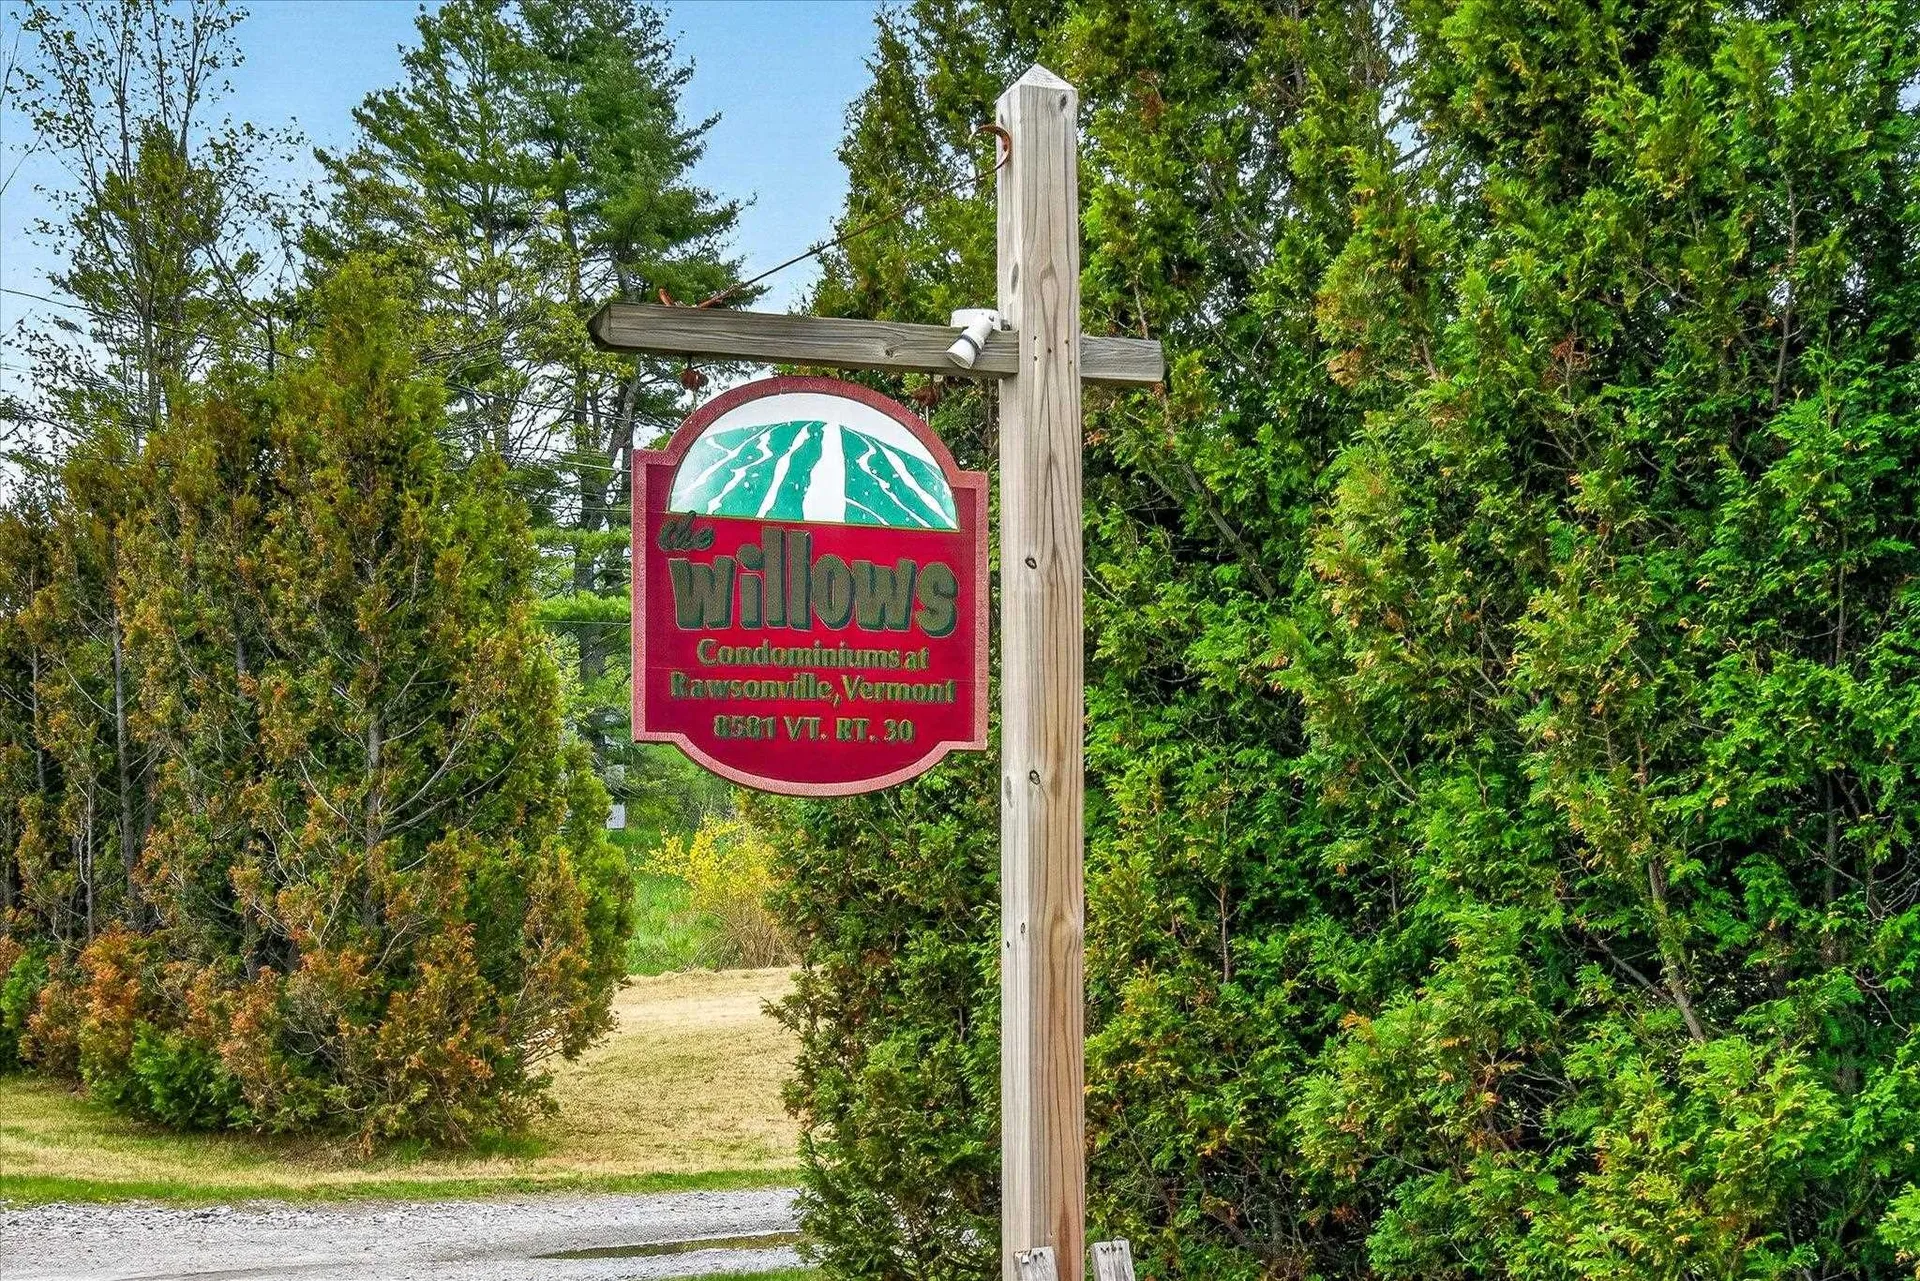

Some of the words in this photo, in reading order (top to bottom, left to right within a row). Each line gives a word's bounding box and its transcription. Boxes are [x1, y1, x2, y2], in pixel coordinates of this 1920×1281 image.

[658, 510, 716, 551] the
[669, 527, 958, 638] willows
[697, 638, 901, 669] Condominiums
[904, 649, 930, 671] at
[670, 672, 842, 710] Rawsonville,
[842, 675, 956, 705] Vermont
[783, 716, 827, 741] VT.
[835, 717, 879, 742] RT.
[883, 718, 916, 743] 30
